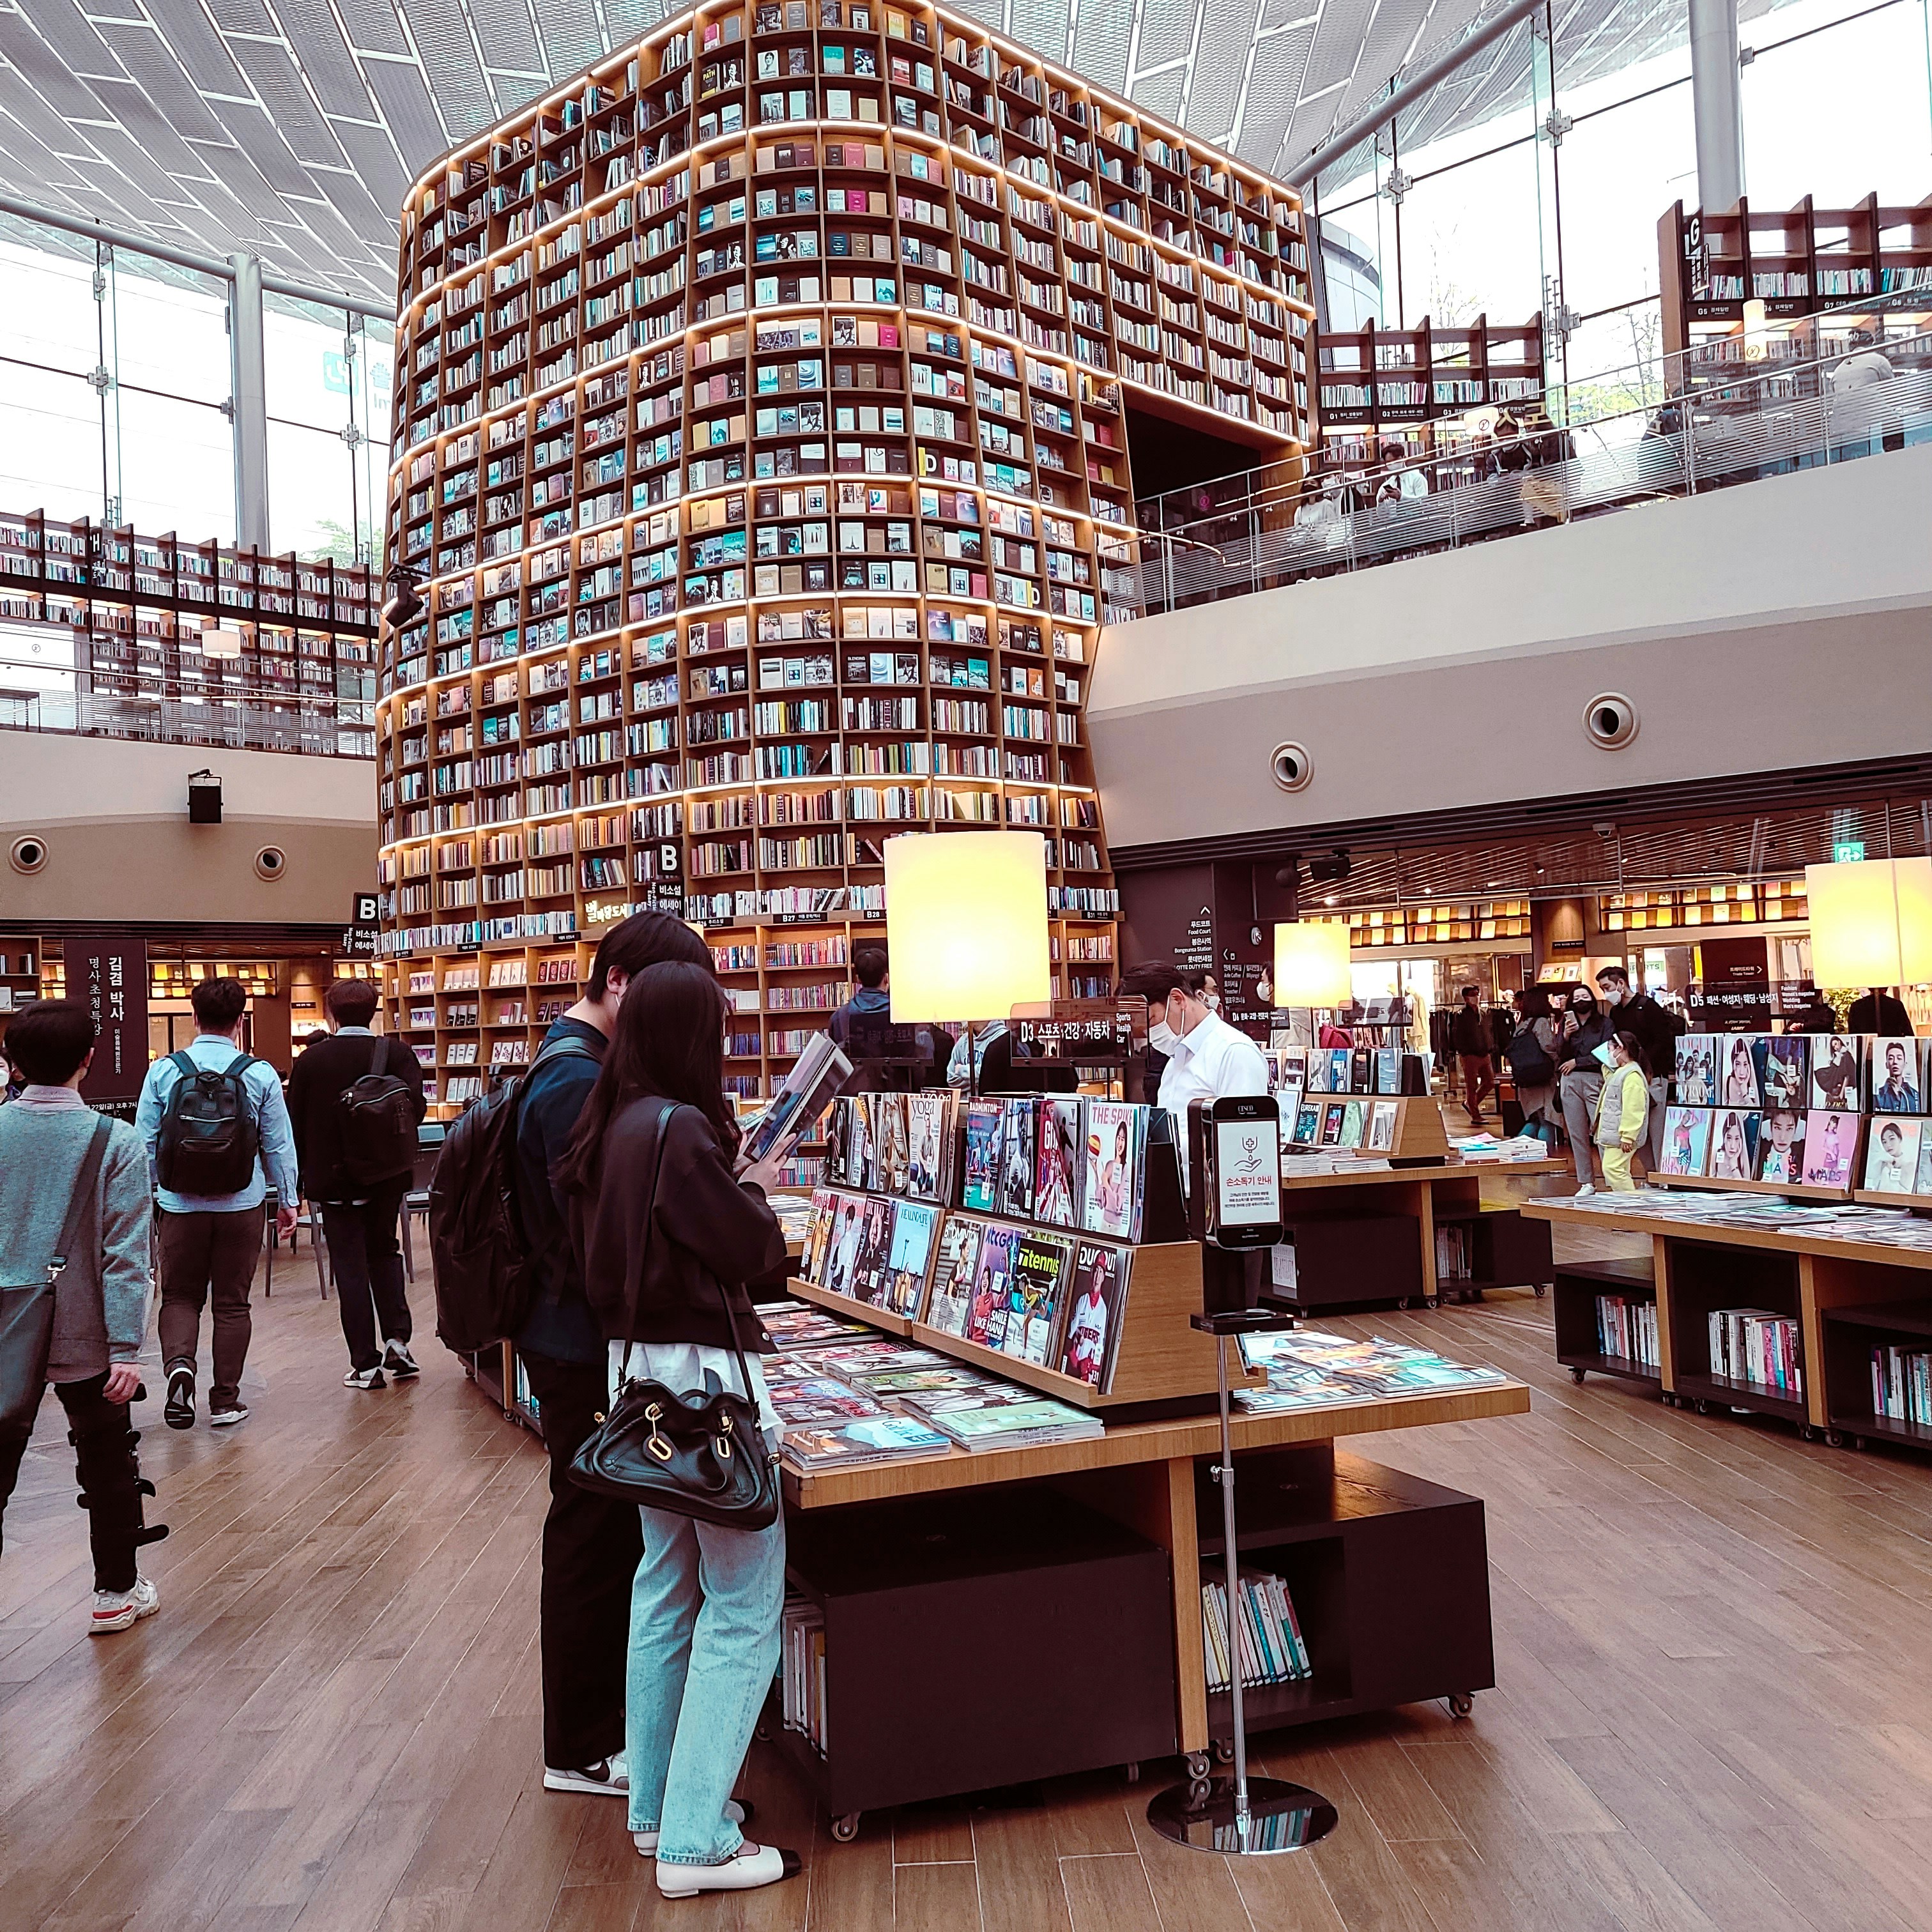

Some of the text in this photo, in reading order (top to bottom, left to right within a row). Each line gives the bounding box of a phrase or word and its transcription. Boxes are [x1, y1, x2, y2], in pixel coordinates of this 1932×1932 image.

[703, 69, 716, 81] PATH
[1690, 218, 1699, 245] G
[93, 533, 100, 553] H
[661, 844, 677, 871] B
[659, 884, 682, 896] 비소설
[360, 898, 376, 919] B
[659, 898, 682, 910] 에세이
[1192, 937, 1212, 946] 봉은사역
[109, 956, 122, 986] 김겸
[110, 991, 124, 1021] 박사
[1690, 994, 1704, 1007] D5
[1116, 1013, 1131, 1023] Sports
[1021, 1022, 1034, 1043] D3
[1116, 1023, 1131, 1032] Health
[1116, 1035, 1125, 1043] Car
[910, 1100, 935, 1121] yoga
[969, 1102, 997, 1114] BADMINTON
[1092, 1107, 1133, 1128] THE SPIKE
[1226, 1176, 1272, 1187] 손소독기 안내
[1029, 1249, 1060, 1275] tennis
[974, 1315, 986, 1330] LIKE
[986, 1320, 1005, 1337] HANA
[990, 1310, 1008, 1326] SMILE
